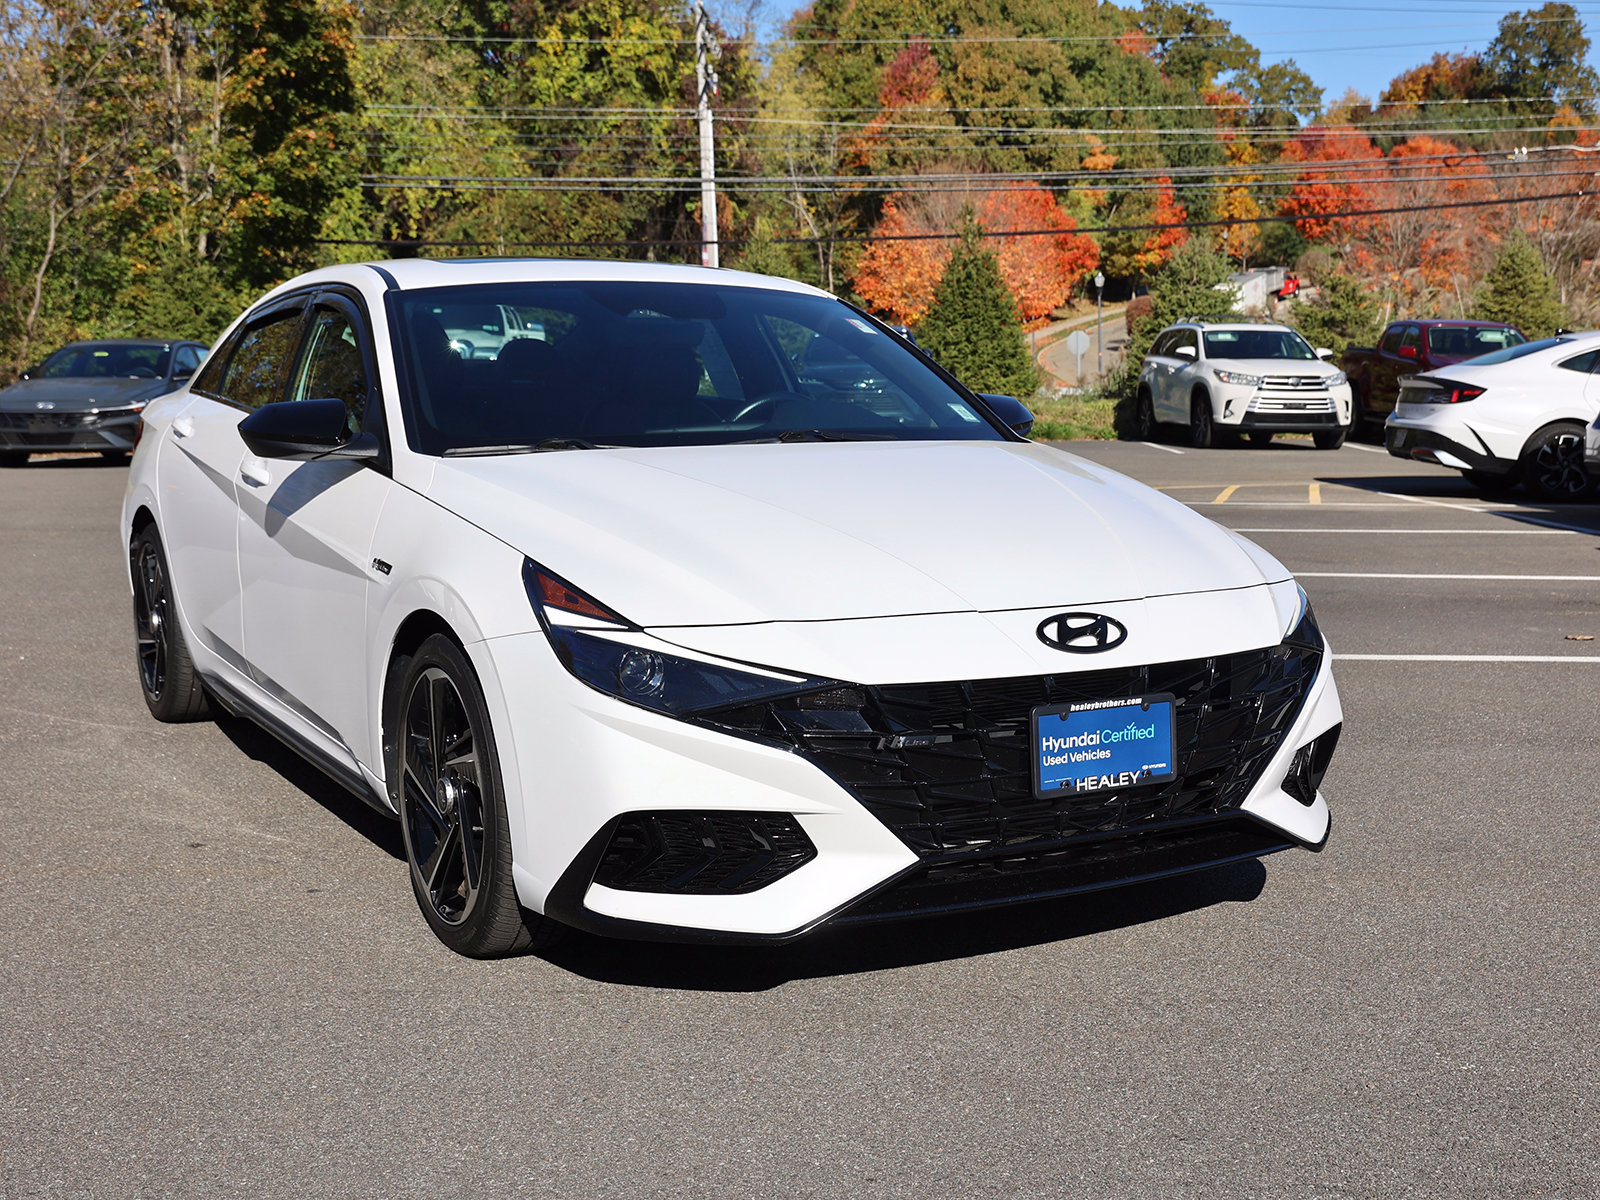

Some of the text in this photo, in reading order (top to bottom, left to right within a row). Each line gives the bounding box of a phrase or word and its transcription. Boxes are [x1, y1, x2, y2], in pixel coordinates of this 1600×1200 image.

[1070, 698, 1142, 712] healeybrothers.com
[1042, 723, 1154, 753] Hyundai Certified
[1043, 749, 1111, 766] Used Vehicles
[1076, 771, 1140, 792] HEALEY
